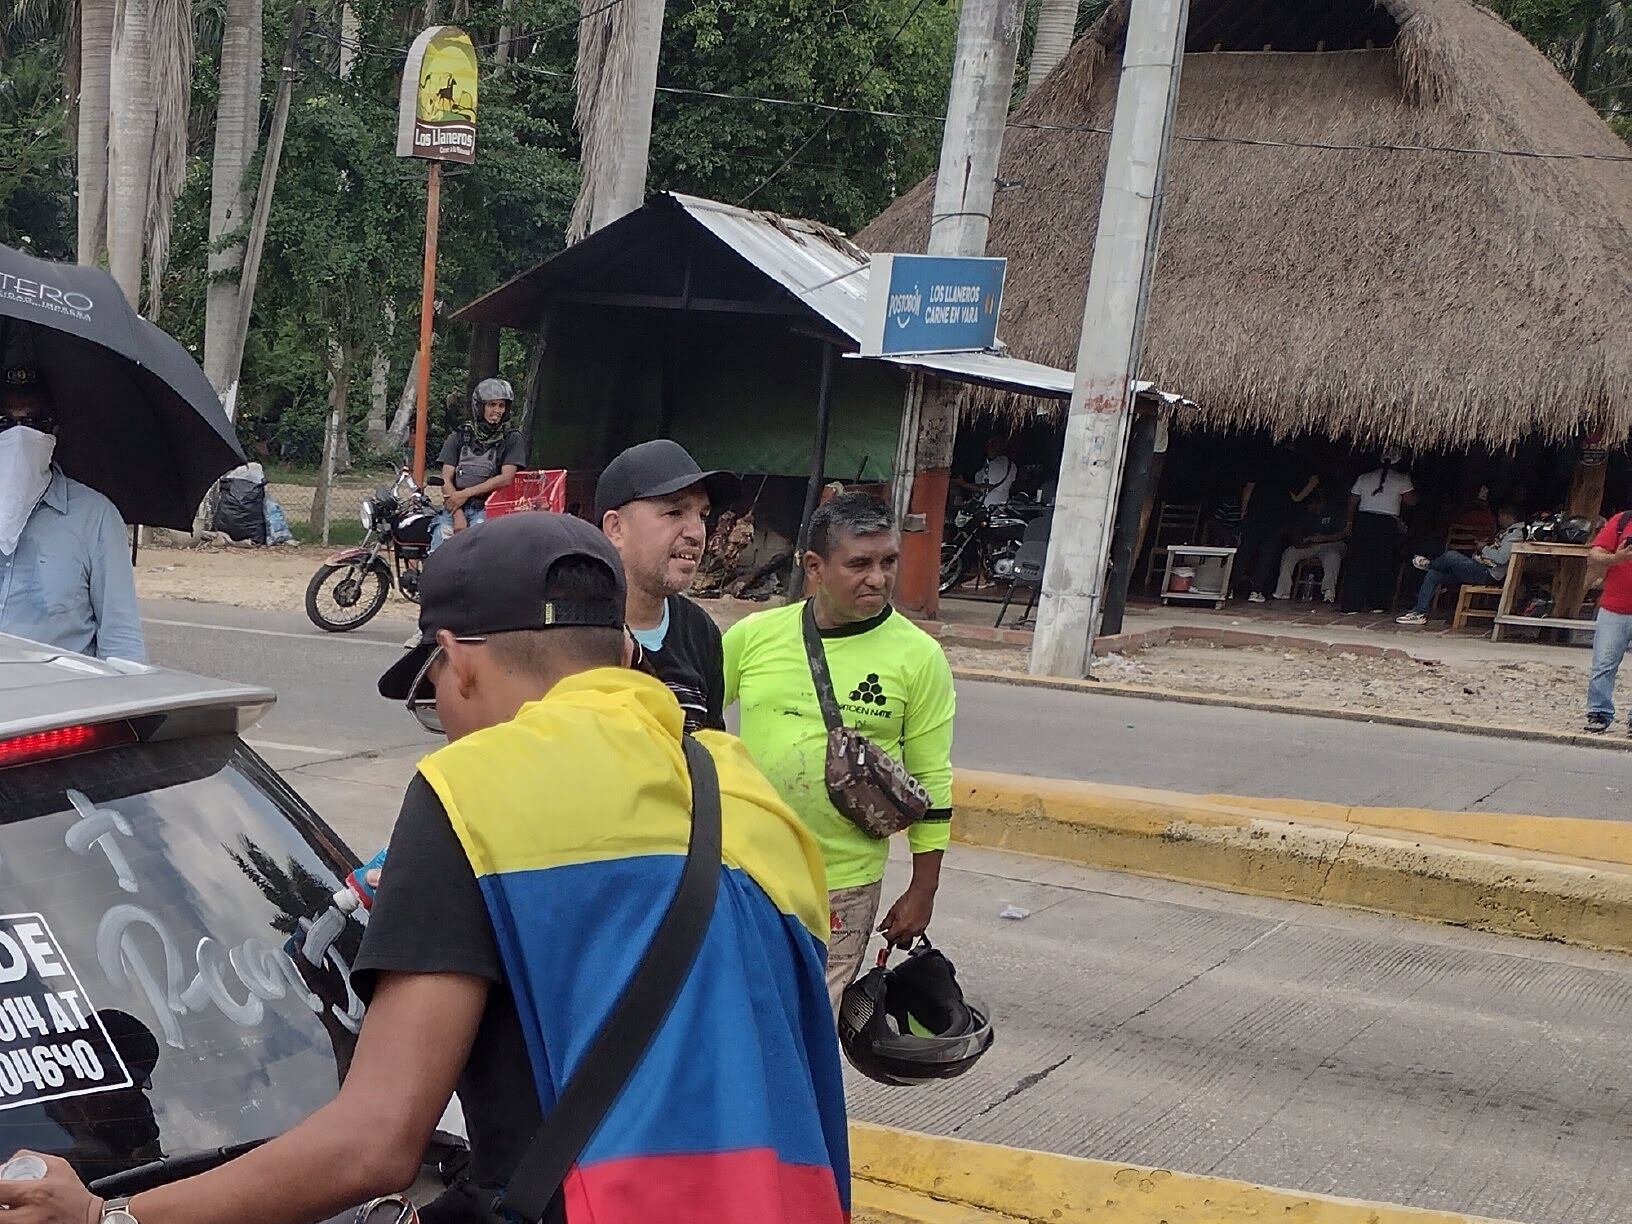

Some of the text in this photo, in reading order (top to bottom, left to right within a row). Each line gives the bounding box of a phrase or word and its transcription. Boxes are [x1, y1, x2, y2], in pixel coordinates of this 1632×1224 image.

[415, 128, 473, 147] Los Llaneros
[929, 285, 980, 303] LOS LLANEROS
[925, 306, 979, 324] CARNE EN VARA
[42, 990, 90, 1034] AT
